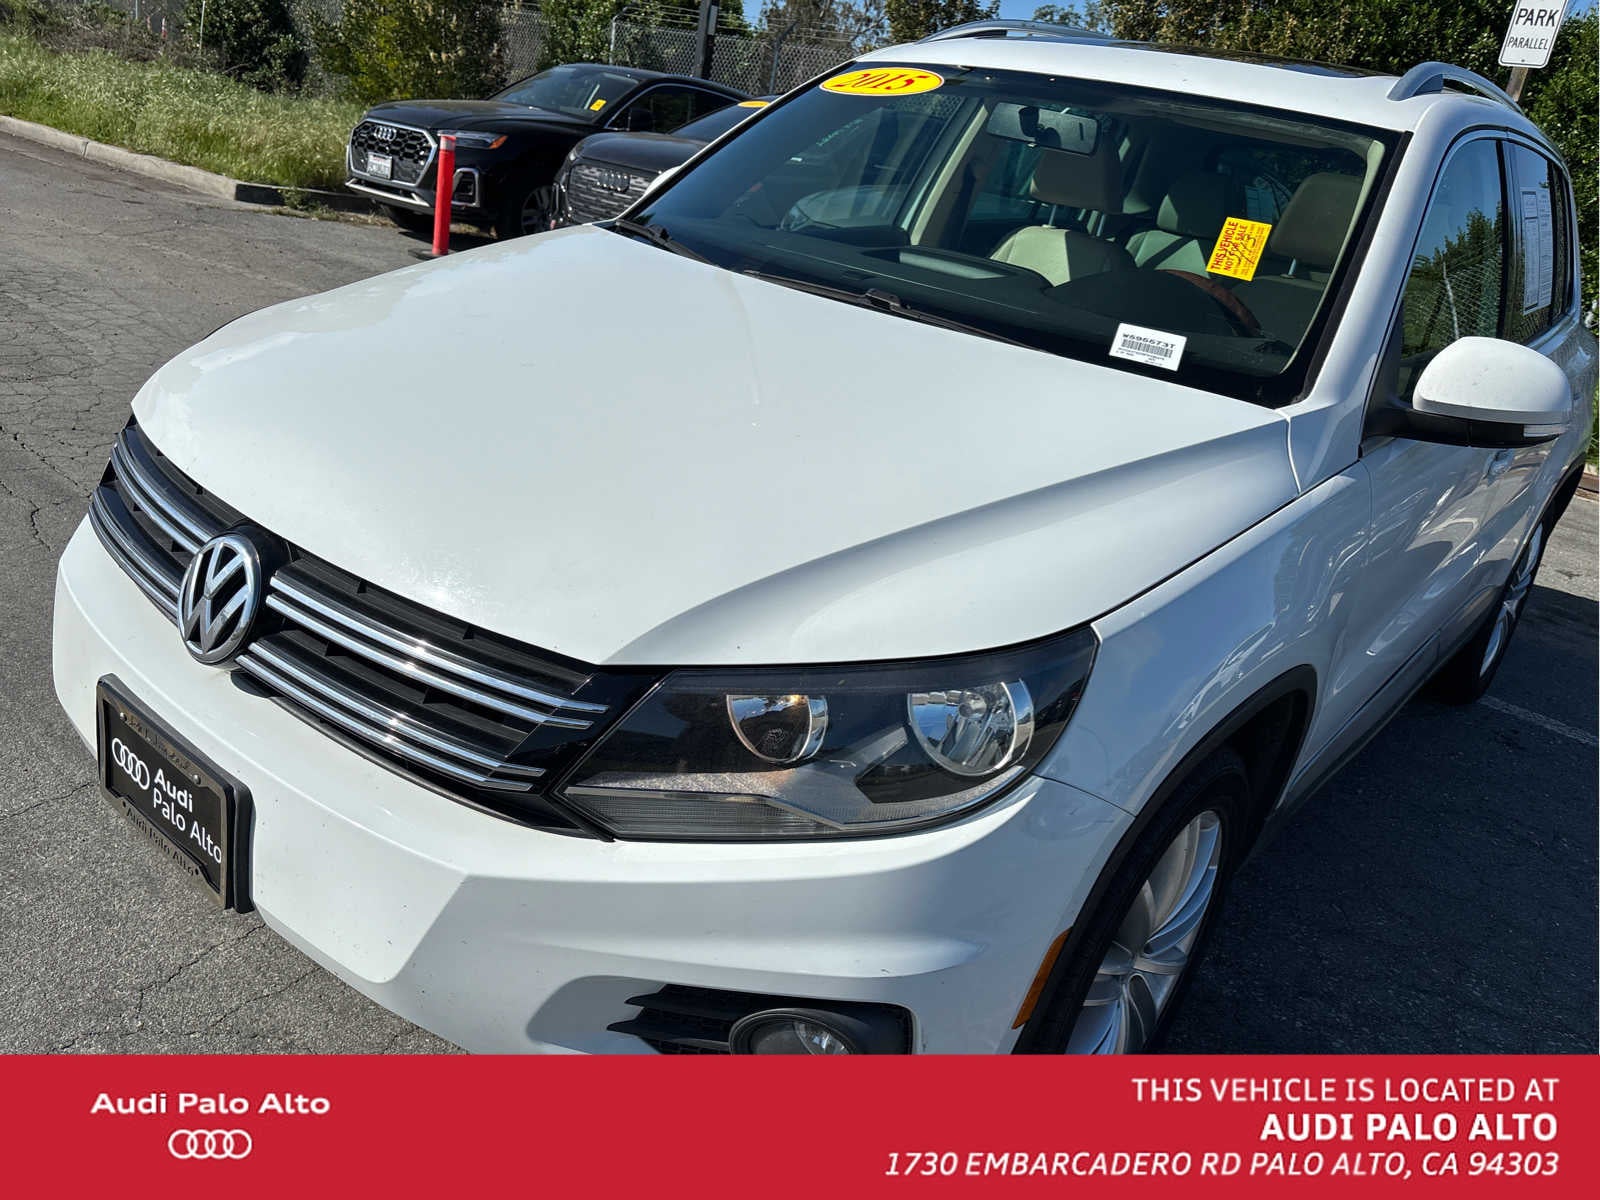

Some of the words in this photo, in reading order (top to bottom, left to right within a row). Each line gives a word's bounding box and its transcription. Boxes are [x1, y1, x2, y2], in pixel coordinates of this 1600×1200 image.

[1514, 8, 1559, 27] PARK
[1507, 36, 1549, 50] PARALLEL
[832, 73, 930, 90] 2015
[1216, 221, 1239, 252] VEHICLE
[1210, 252, 1227, 270] THIS
[154, 767, 193, 813] Audi
[153, 789, 187, 832] Palo
[190, 821, 222, 864] Alto
